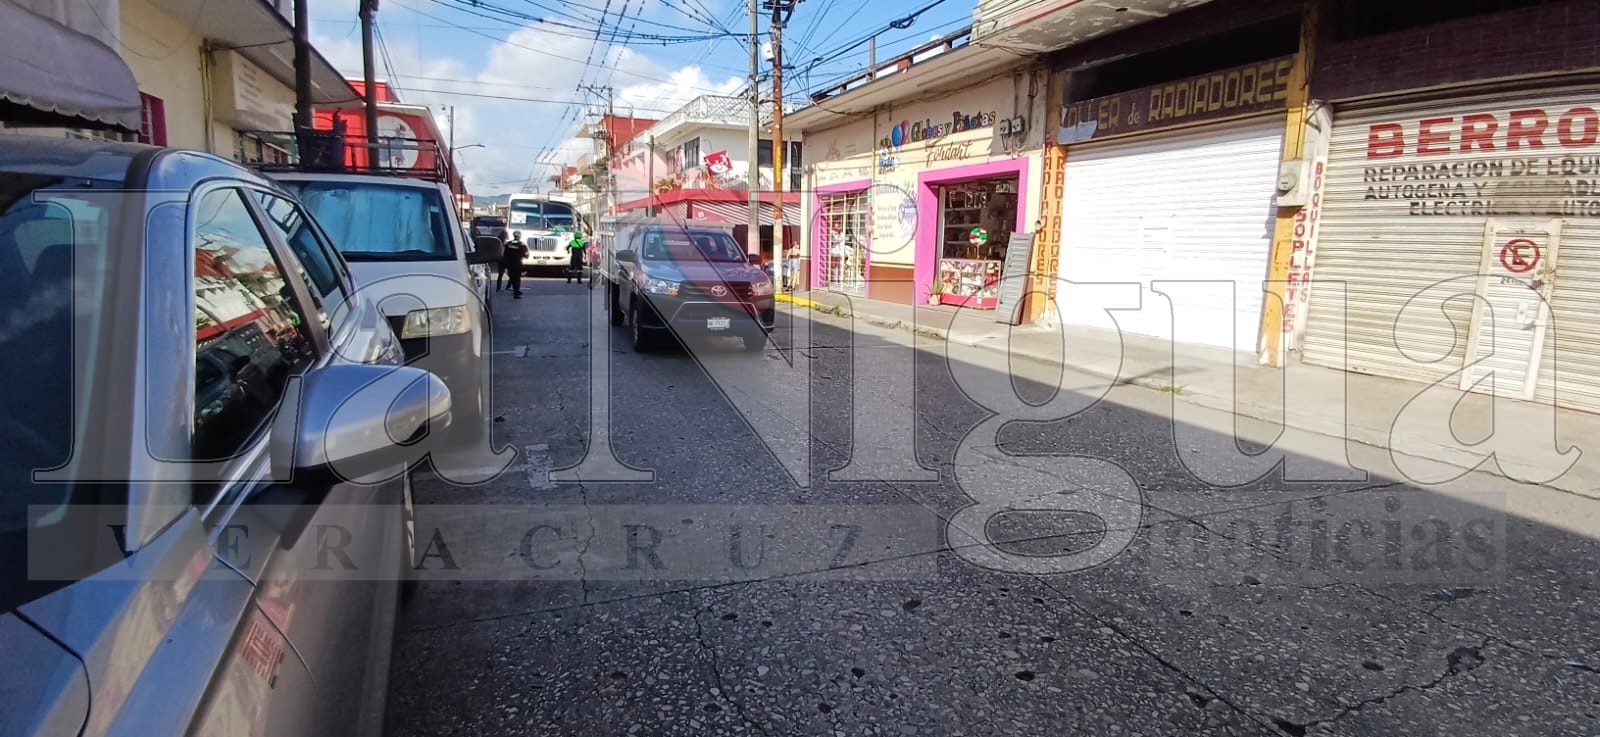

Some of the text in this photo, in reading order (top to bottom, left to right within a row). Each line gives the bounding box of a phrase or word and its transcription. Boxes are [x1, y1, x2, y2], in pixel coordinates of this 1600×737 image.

[1064, 59, 1293, 131] ALLER de RADIADORES
[925, 137, 973, 168] Fondant
[1366, 107, 1599, 160] BERRO
[1363, 159, 1503, 182] REPARACION
[1510, 159, 1538, 176] DE
[1363, 181, 1467, 200] AUTOGENA
[1473, 181, 1487, 197] Y
[1301, 161, 1324, 302] BOQUILLAS
[1283, 207, 1307, 331] SOPLETES
